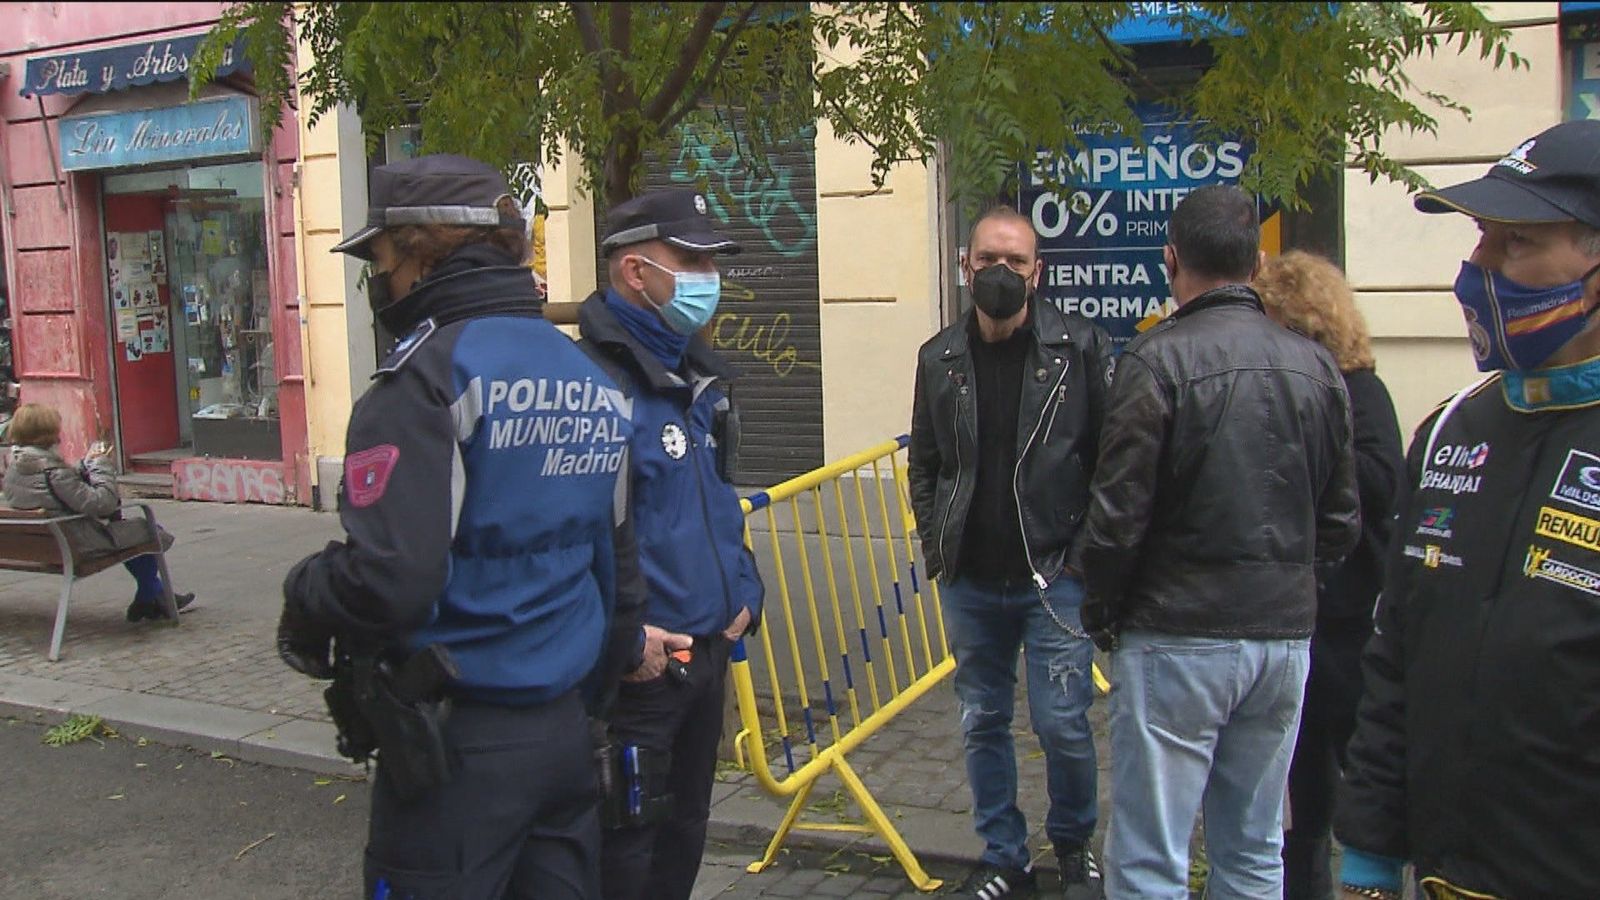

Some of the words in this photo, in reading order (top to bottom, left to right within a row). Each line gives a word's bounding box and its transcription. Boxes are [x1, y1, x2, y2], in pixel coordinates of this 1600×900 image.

[36, 58, 88, 90] Plata
[101, 65, 114, 91] y
[126, 43, 234, 80] Artesa
[1031, 135, 1244, 185] EMPEÑOS
[1126, 220, 1169, 237] PRIM
[487, 376, 613, 414] POLICÍA
[488, 415, 626, 450] MUNICIPAL
[540, 443, 627, 478] Madrid
